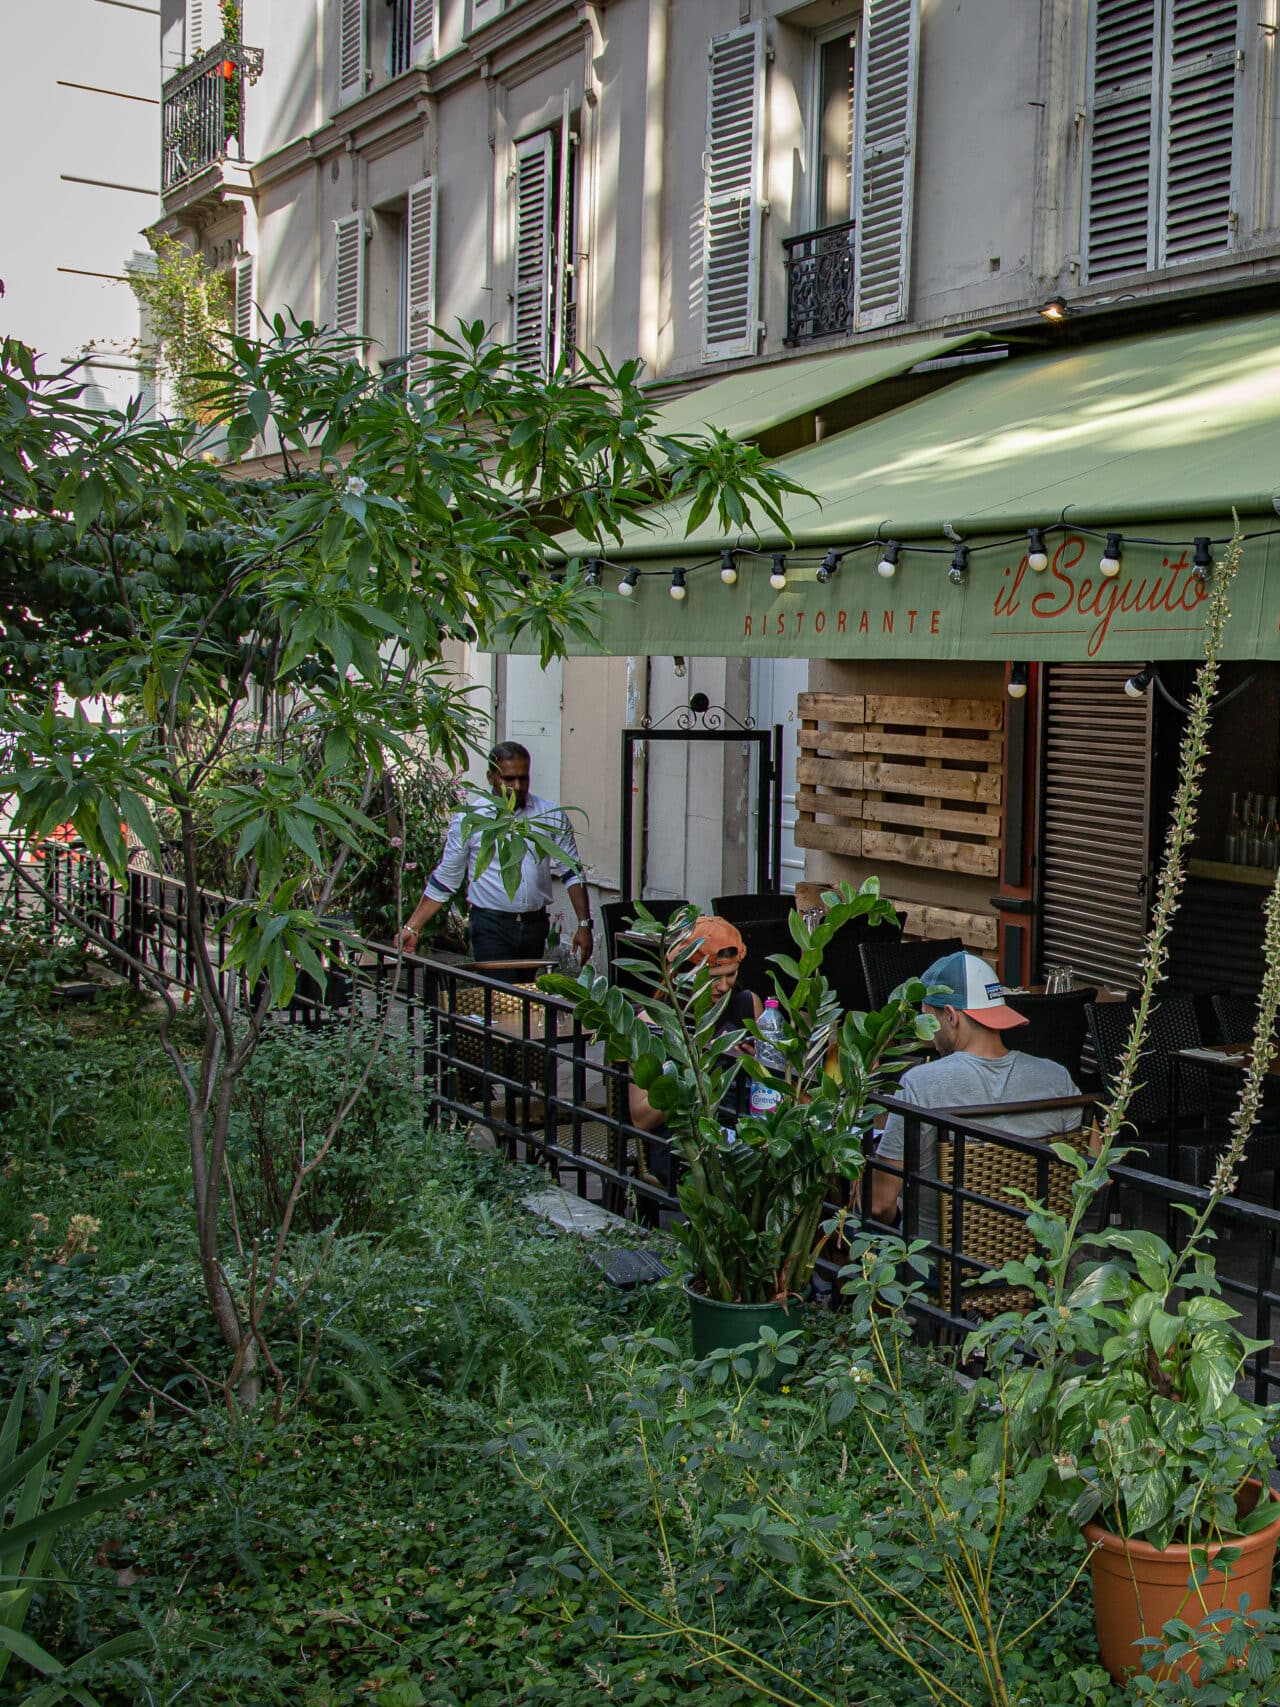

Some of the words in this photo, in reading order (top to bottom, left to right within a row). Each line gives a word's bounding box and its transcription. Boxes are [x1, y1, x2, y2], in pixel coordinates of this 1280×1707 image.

[744, 610, 941, 636] RISTORANTE
[994, 555, 1028, 617] il
[1031, 536, 1209, 657] Seguito
